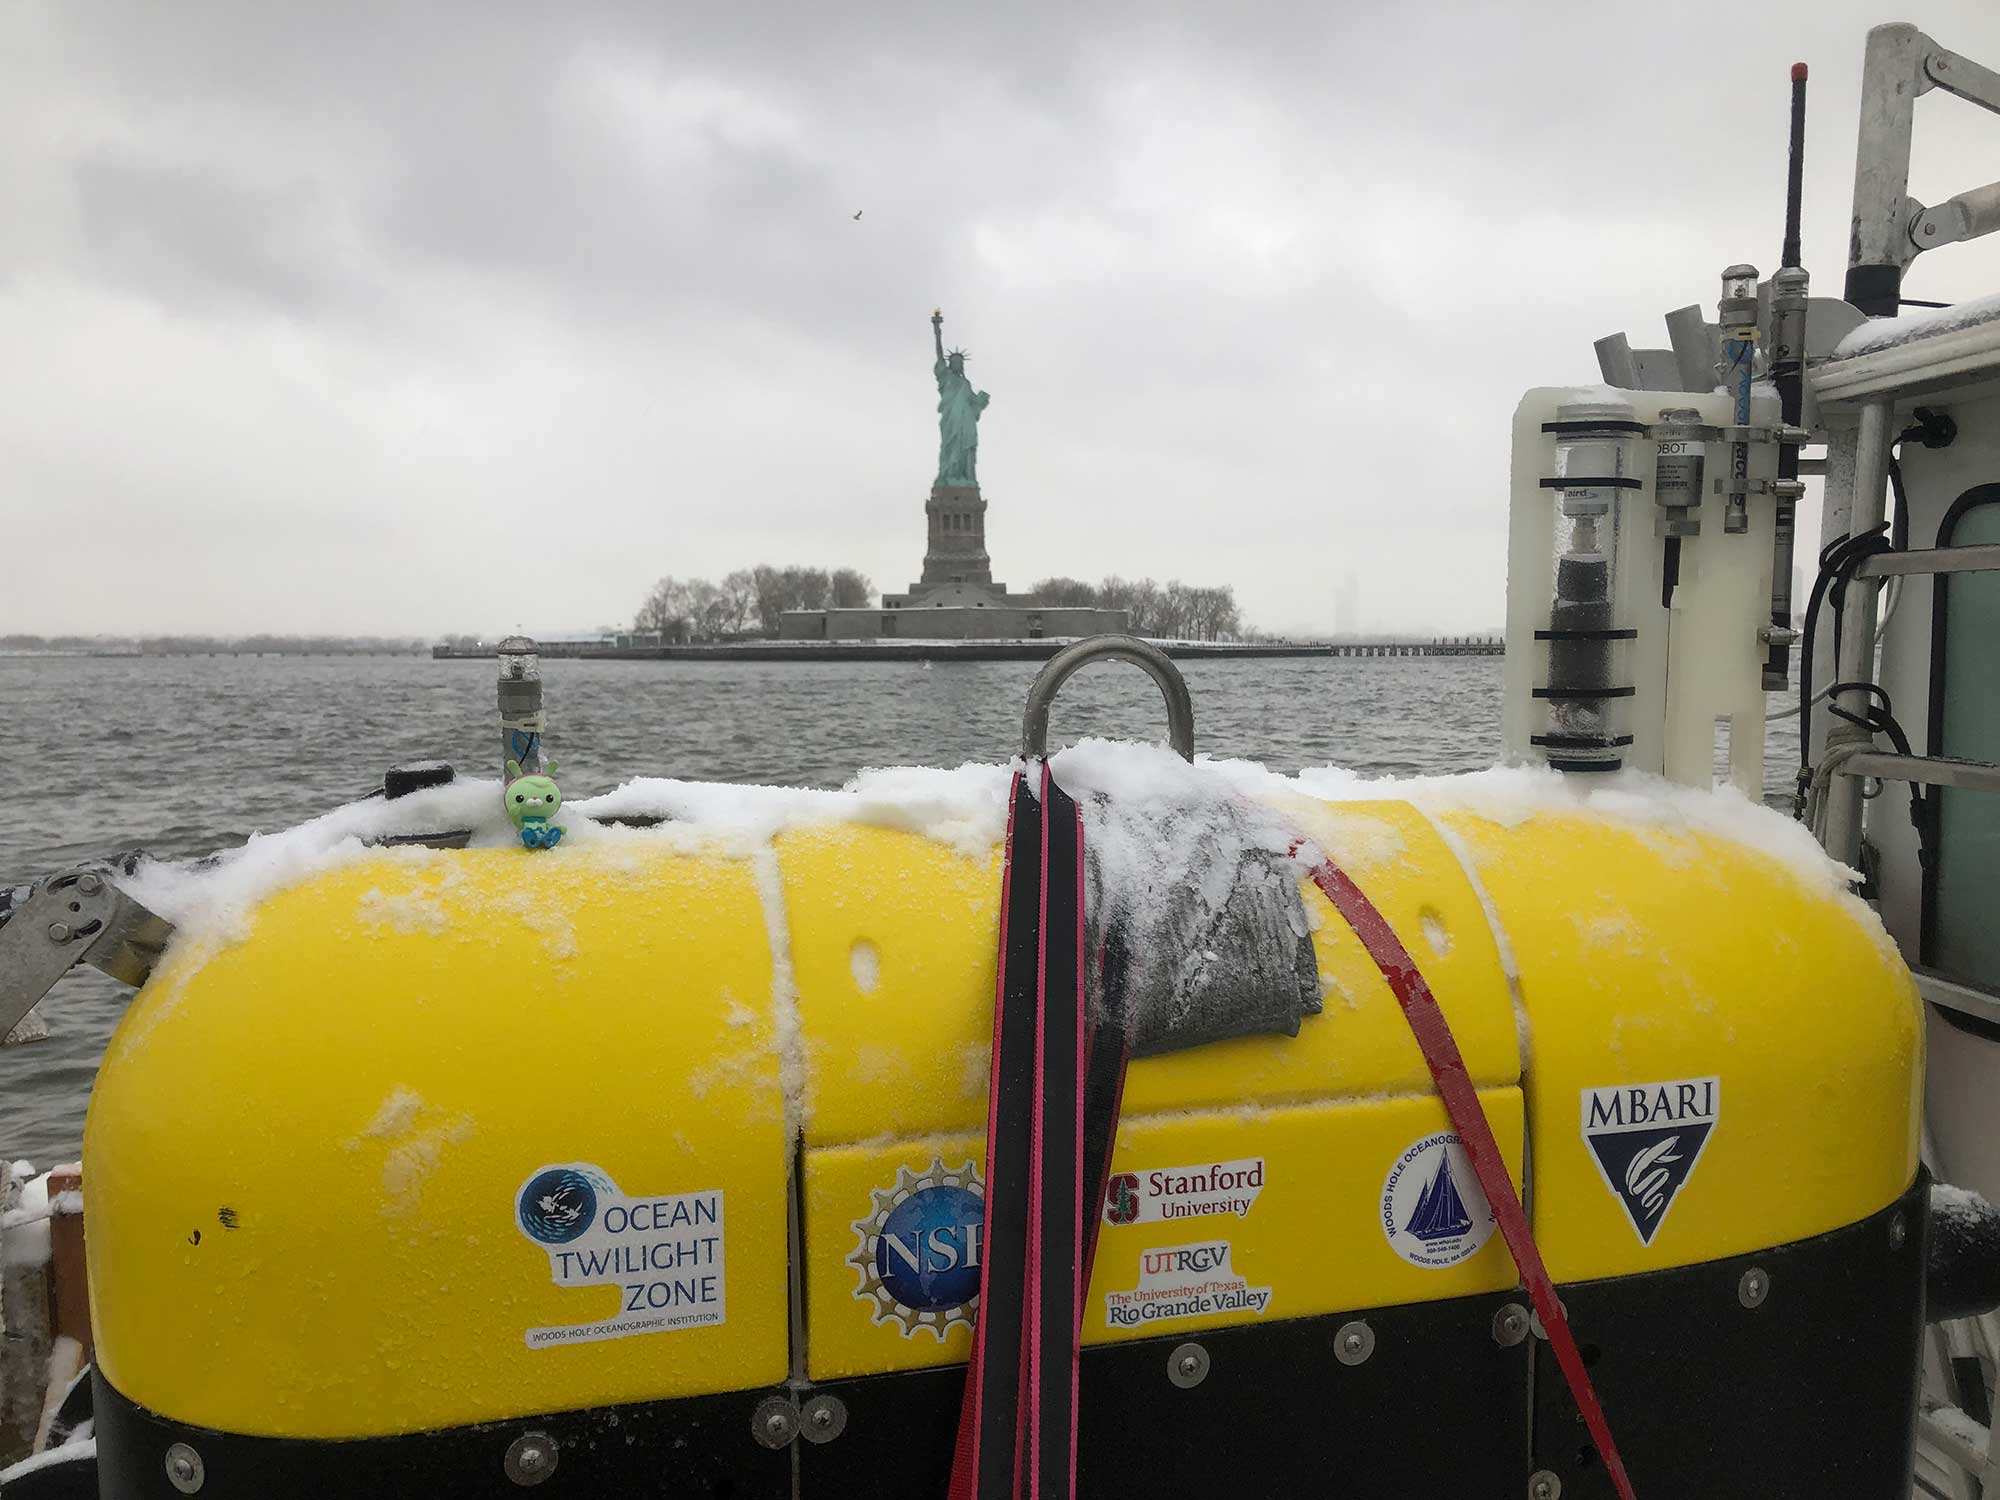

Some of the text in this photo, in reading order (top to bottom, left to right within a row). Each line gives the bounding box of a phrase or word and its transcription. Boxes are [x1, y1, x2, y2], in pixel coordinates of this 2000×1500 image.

[1586, 1082, 1714, 1128] MBARI
[1149, 1161, 1263, 1197] Stanford
[1383, 1134, 1464, 1238] WOODS HOLE OCEANOGR
[604, 1197, 717, 1233] OCEAN
[1161, 1197, 1250, 1219] University
[556, 1237, 719, 1279] TWILIGHT
[1144, 1246, 1228, 1274] UTRGV
[1408, 1251, 1431, 1265] WOODS
[1450, 1254, 1461, 1262] MA
[626, 1276, 718, 1312] ZONE
[1109, 1281, 1245, 1305] The University of Texas
[1110, 1290, 1269, 1325] Rio Grande Valley
[532, 1312, 719, 1342] WOODS HOLE OCEANOGRAPHIC INSTITUTION
